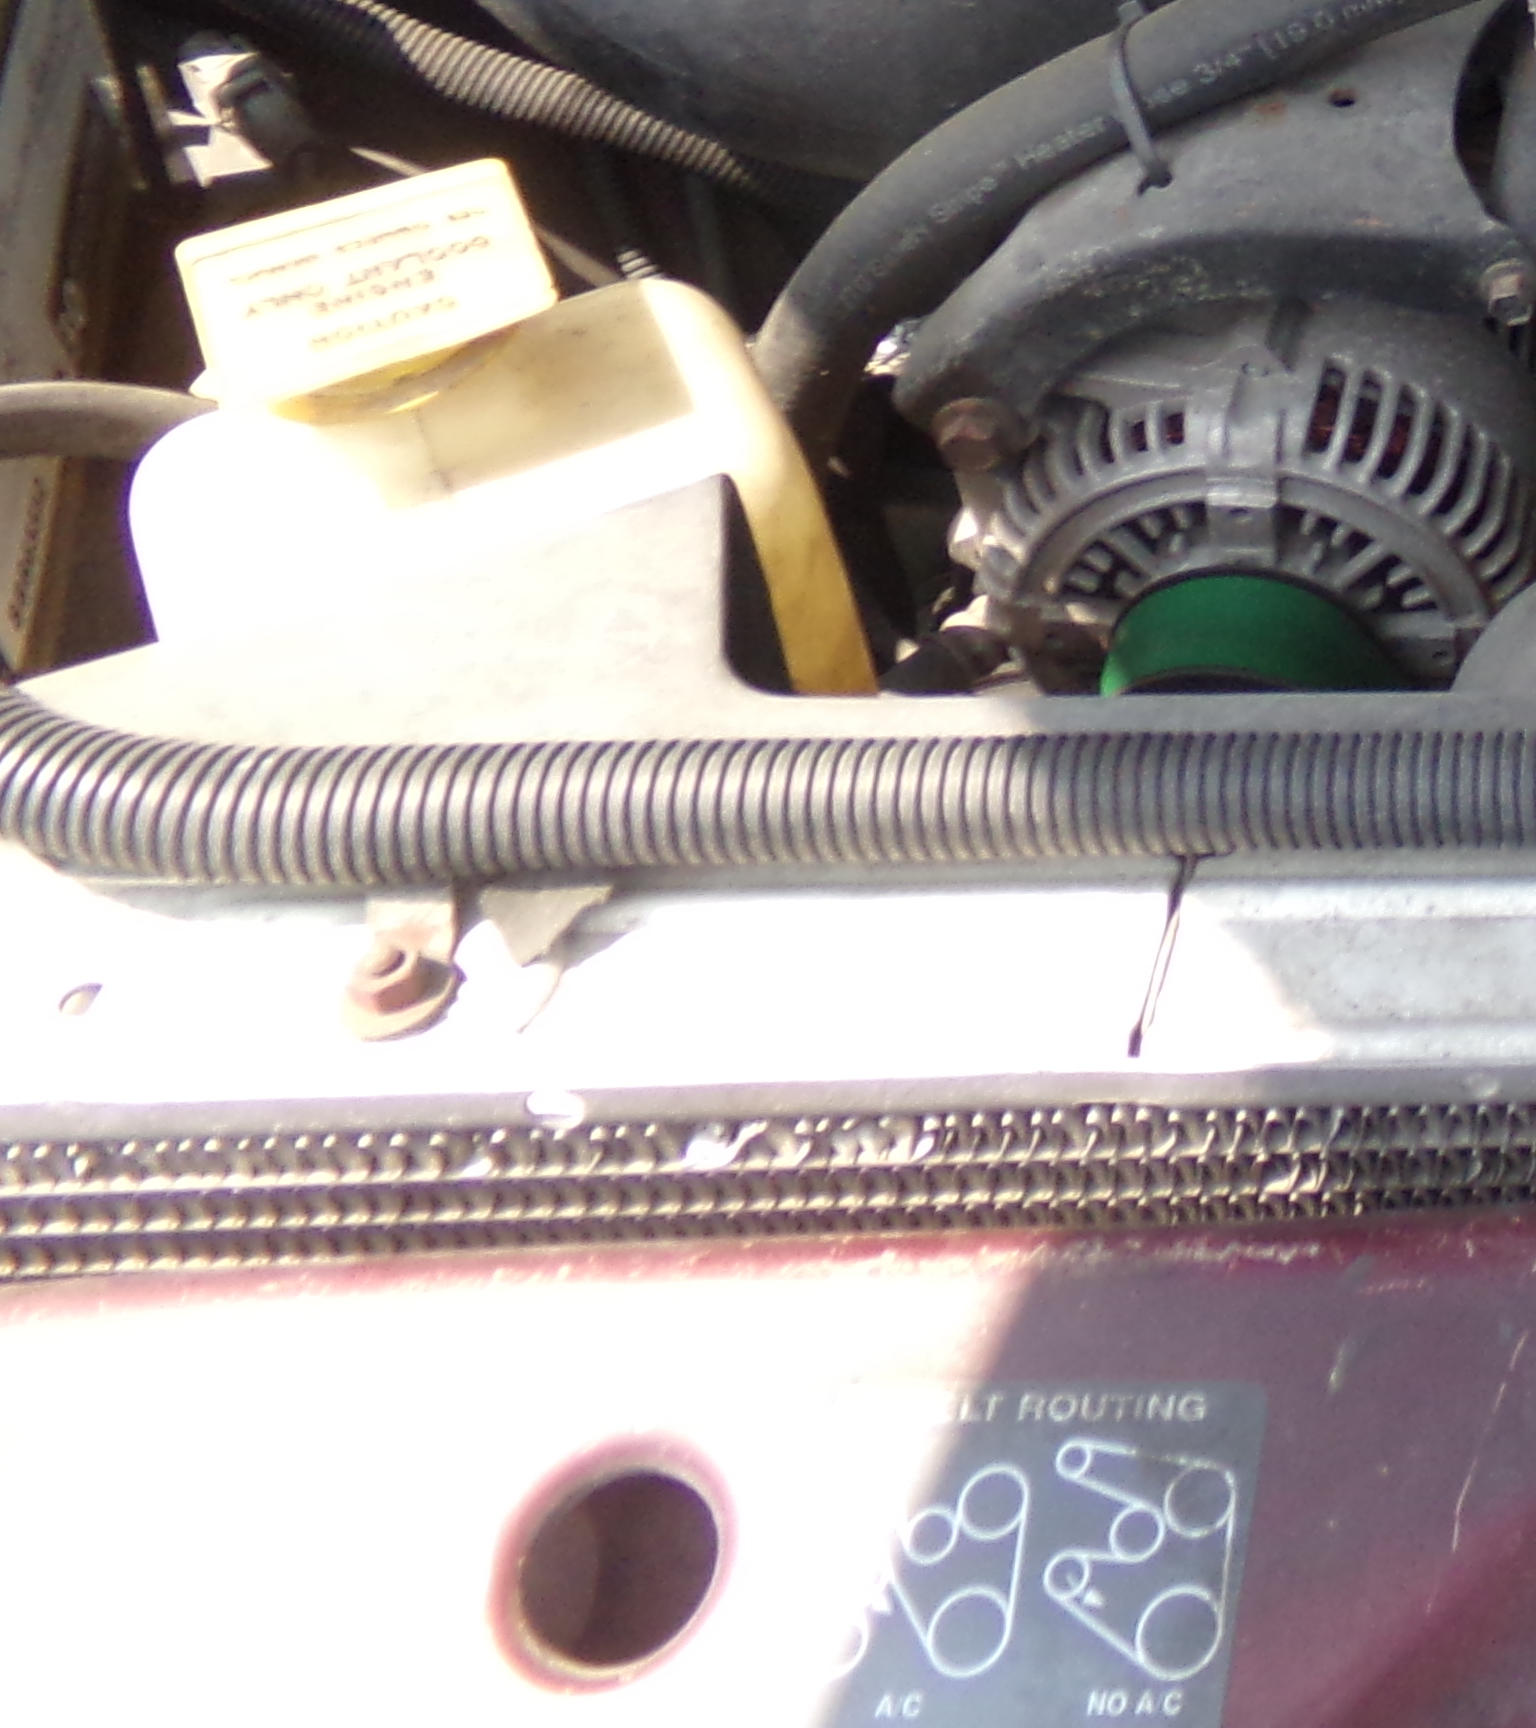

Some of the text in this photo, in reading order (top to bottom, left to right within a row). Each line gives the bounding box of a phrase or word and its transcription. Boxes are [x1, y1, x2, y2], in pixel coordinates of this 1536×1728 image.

[347, 234, 491, 287] COOLANT
[313, 266, 436, 314] ENGINE
[1016, 1392, 1209, 1424] ROUTING
[1086, 1690, 1127, 1718] NO
